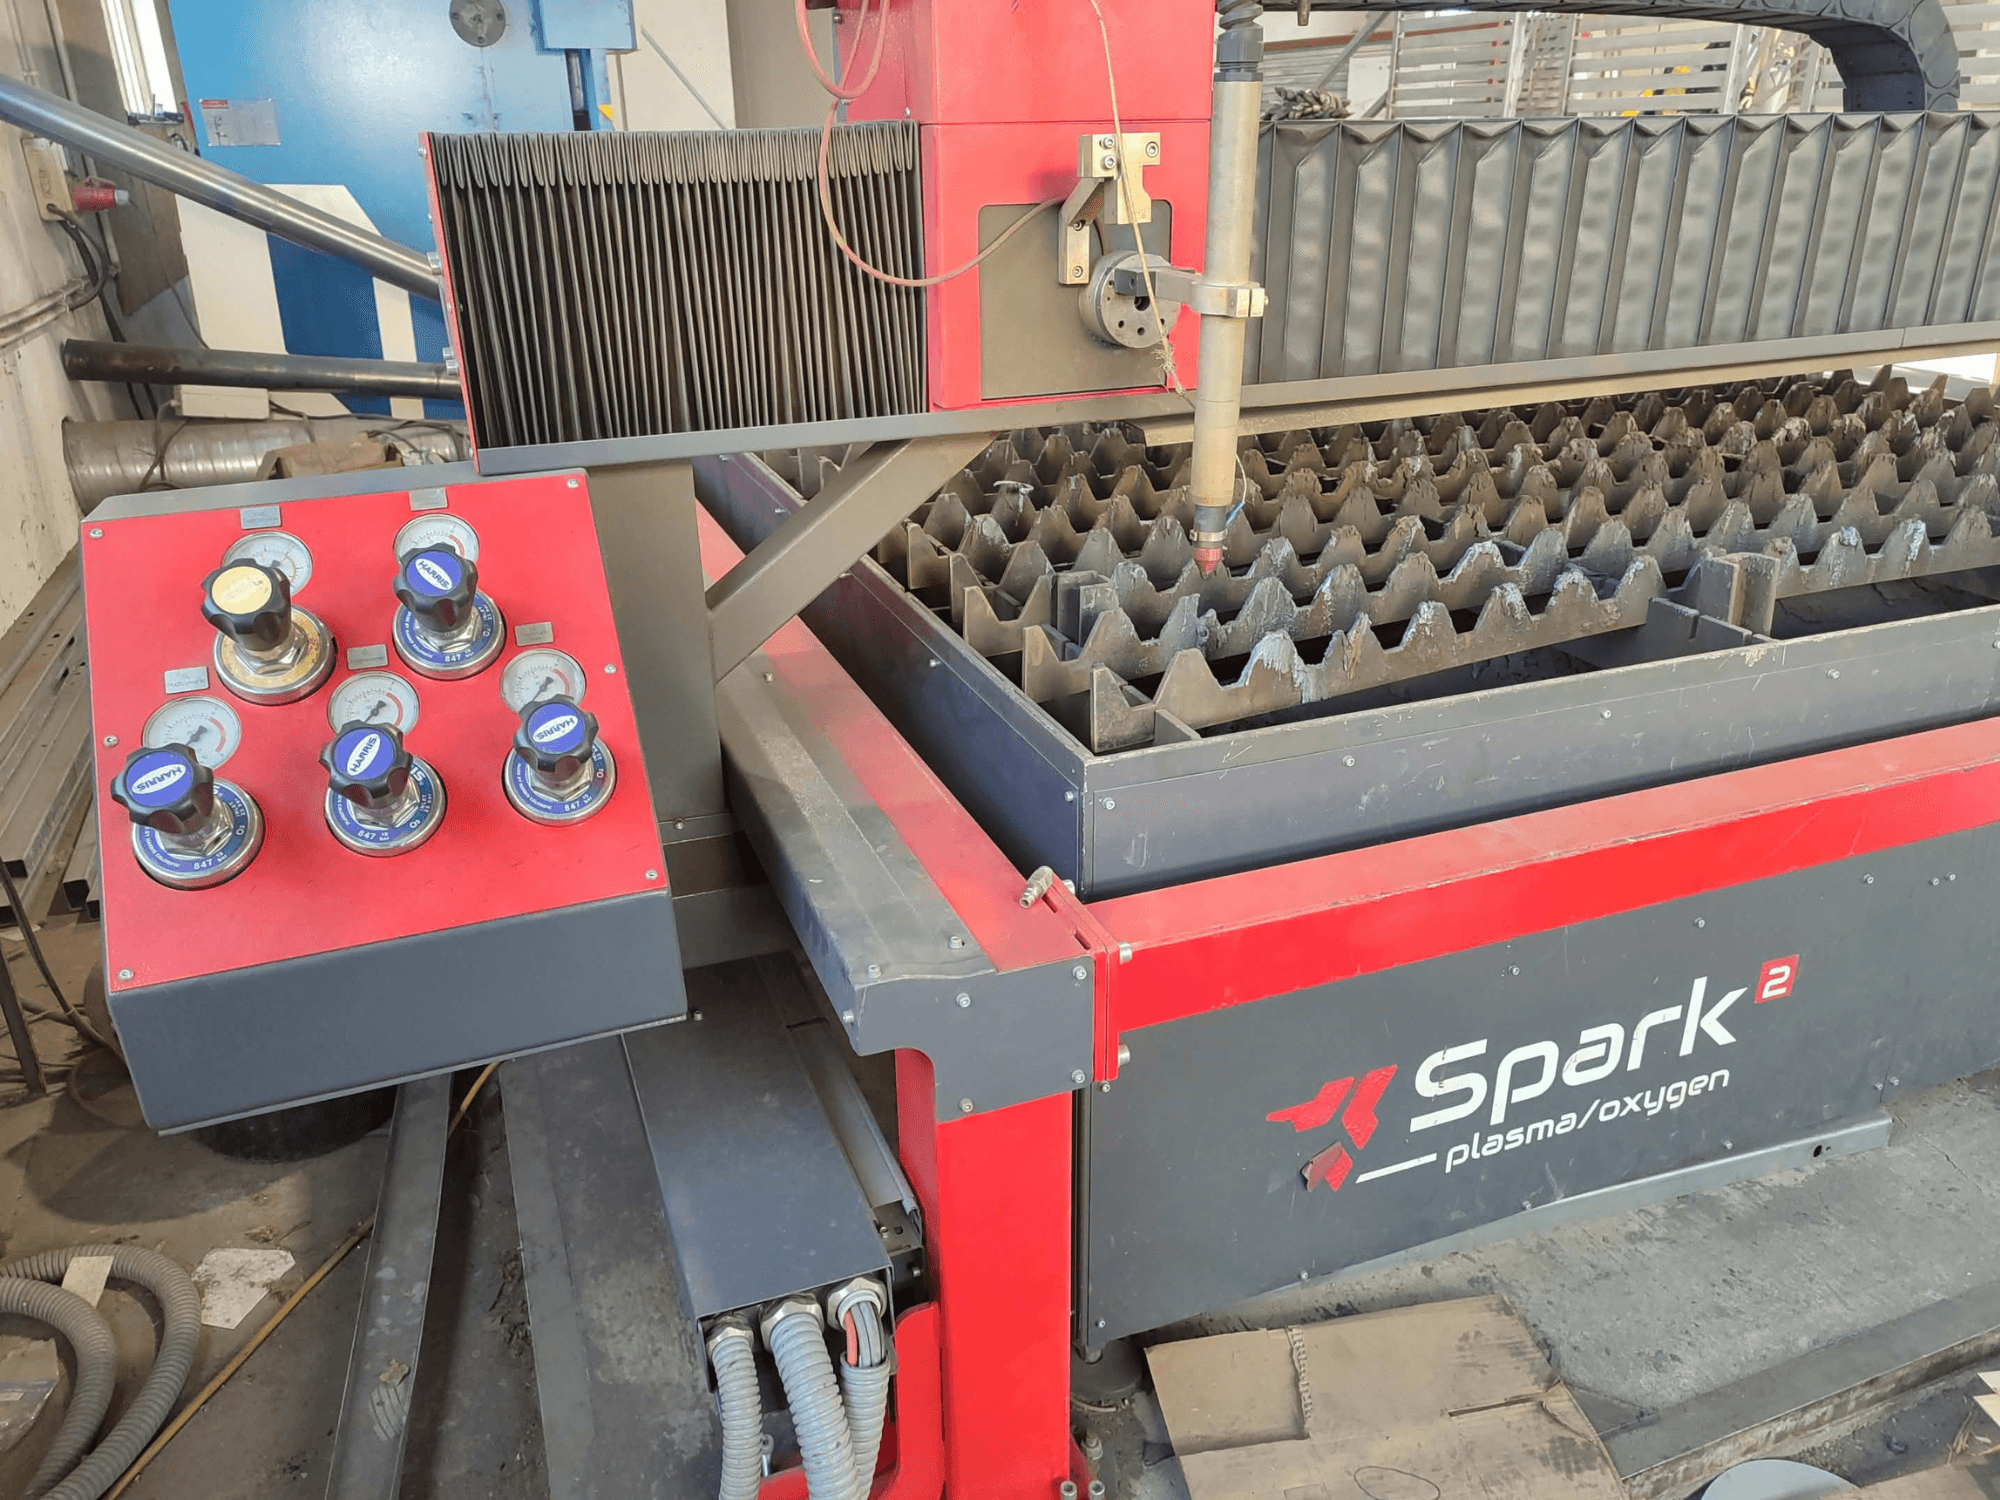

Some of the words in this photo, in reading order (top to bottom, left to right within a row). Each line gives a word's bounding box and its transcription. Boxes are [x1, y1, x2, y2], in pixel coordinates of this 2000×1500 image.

[419, 560, 450, 589] HARRIS
[445, 653, 461, 663] 847
[536, 717, 575, 741] HARRIS
[349, 736, 377, 773] HARRIS
[137, 766, 182, 791] HARRIS
[564, 801, 580, 811] 847
[357, 830, 376, 840] 847
[194, 858, 213, 870] 847
[1410, 976, 1749, 1133] Spark
[1761, 965, 1791, 999] 2
[1445, 1068, 1731, 1174] plasma/oxygen
